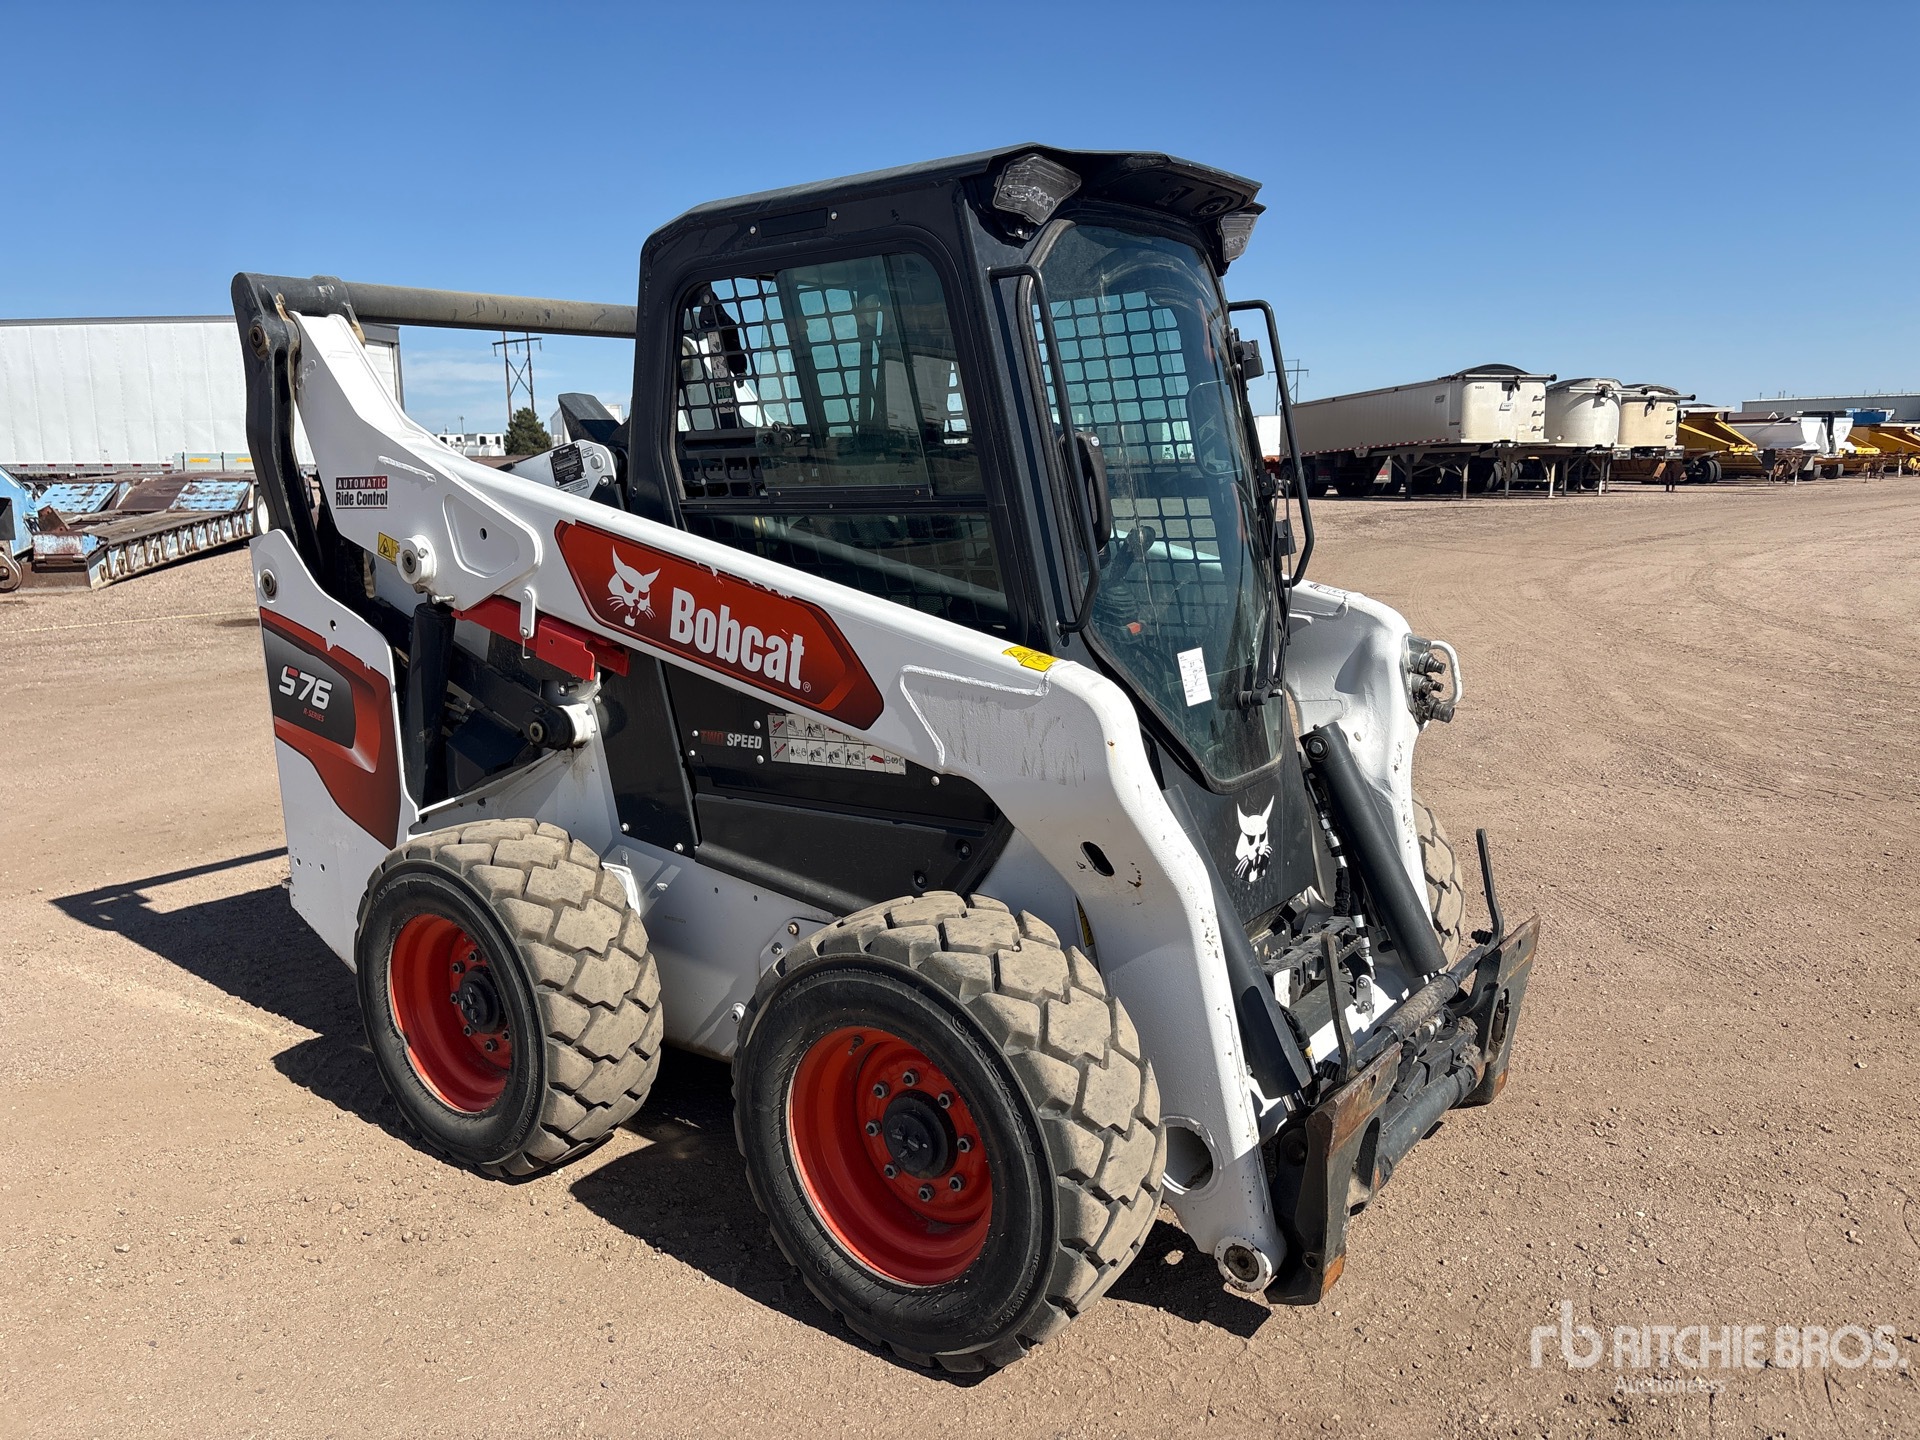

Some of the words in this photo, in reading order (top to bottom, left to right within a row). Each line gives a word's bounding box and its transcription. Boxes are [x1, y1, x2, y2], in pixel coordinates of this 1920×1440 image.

[337, 478, 386, 489] AUTOMATIC
[336, 491, 354, 506] Ride
[356, 490, 388, 506] Control
[669, 586, 805, 690] Bobcat
[278, 665, 333, 710] S76
[701, 731, 725, 746] TWO
[726, 732, 763, 749] SPEED
